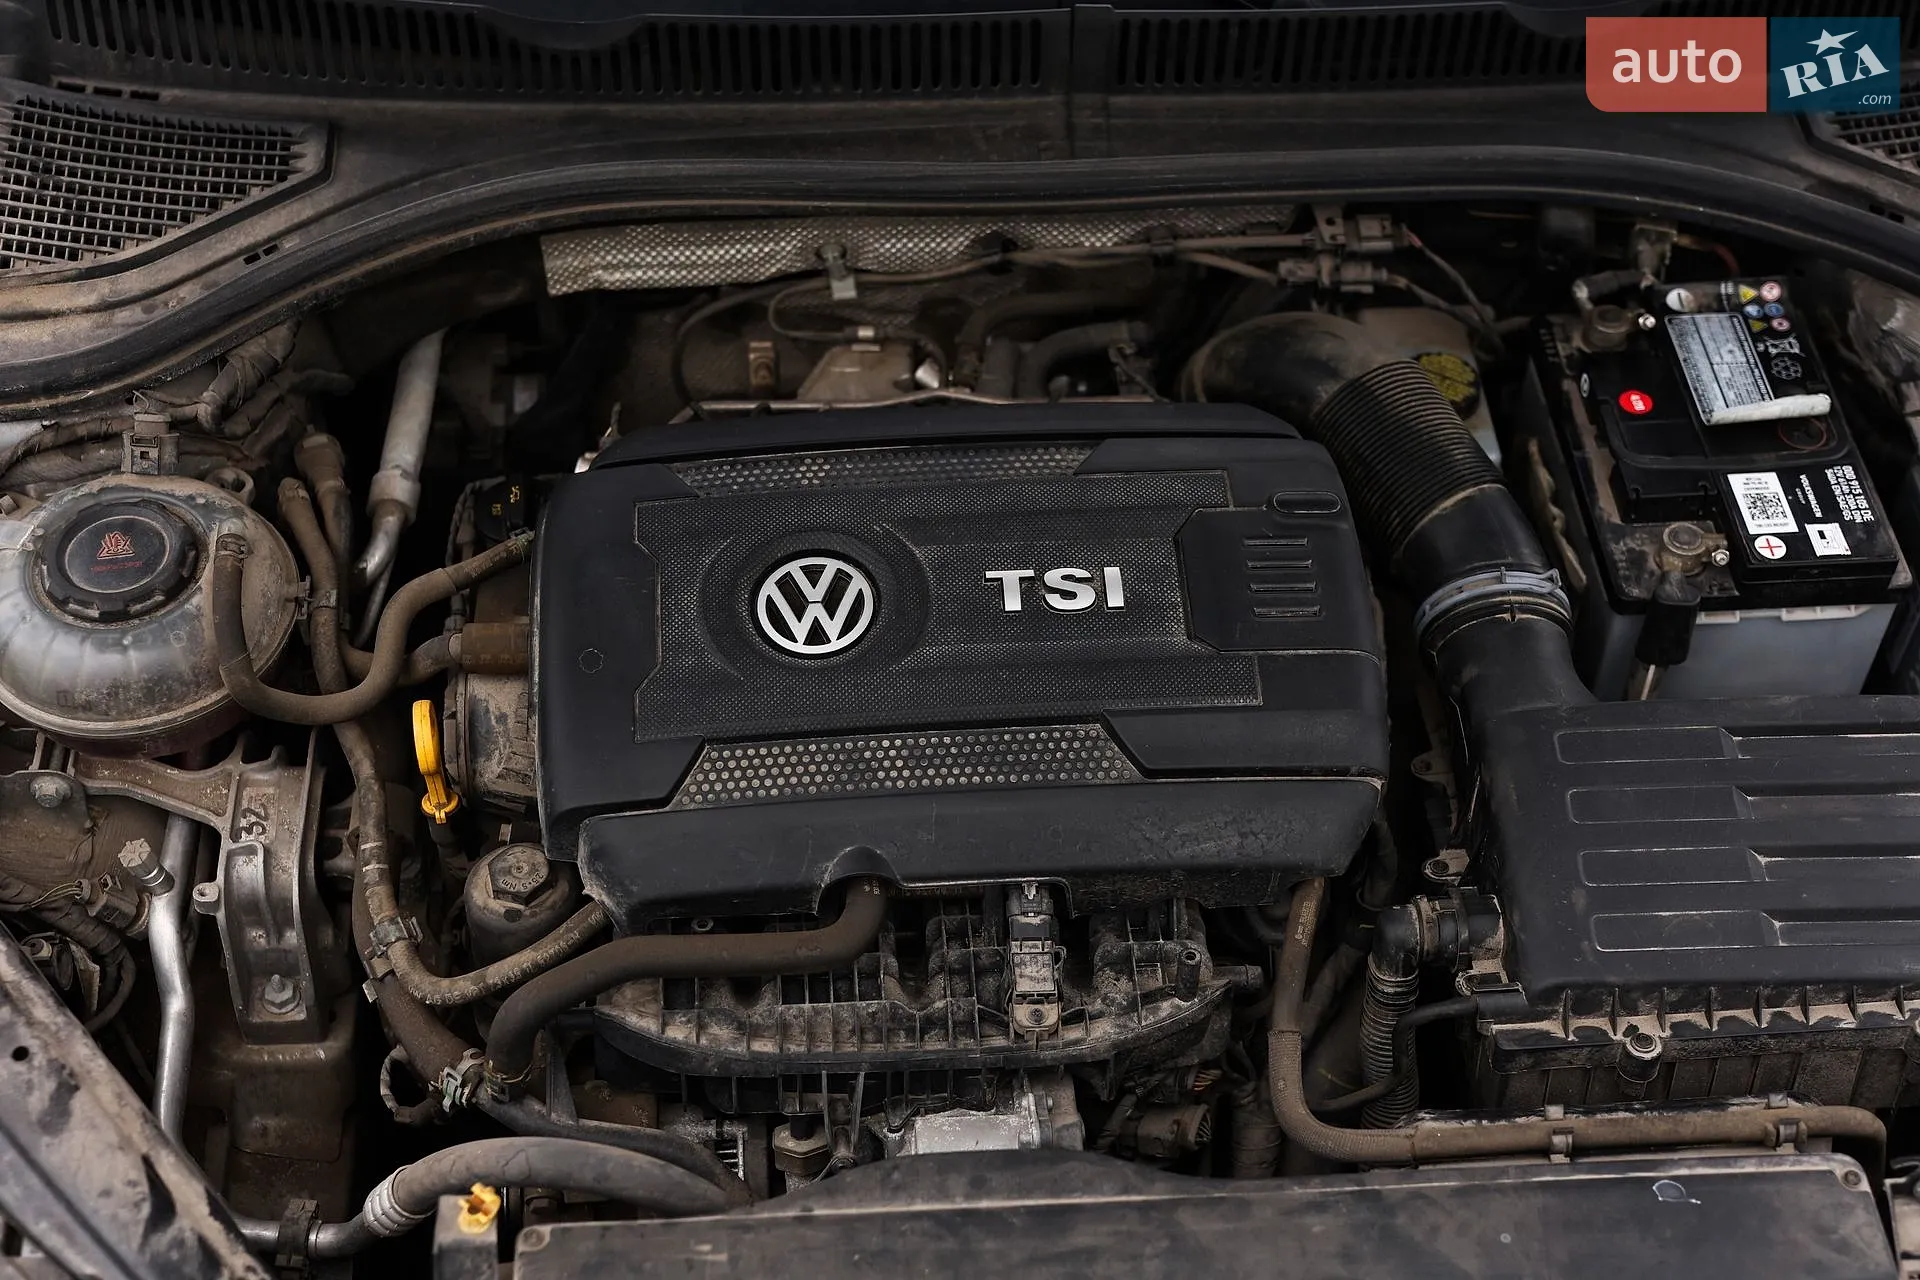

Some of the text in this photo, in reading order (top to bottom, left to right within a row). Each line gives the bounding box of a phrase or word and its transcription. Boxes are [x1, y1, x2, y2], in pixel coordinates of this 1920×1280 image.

[1800, 474, 1823, 518] VOLKSWAGEN
[1861, 509, 1874, 522] DE
[1851, 510, 1864, 523] DIN
[984, 567, 1125, 614] TSI
[230, 803, 269, 843] 32
